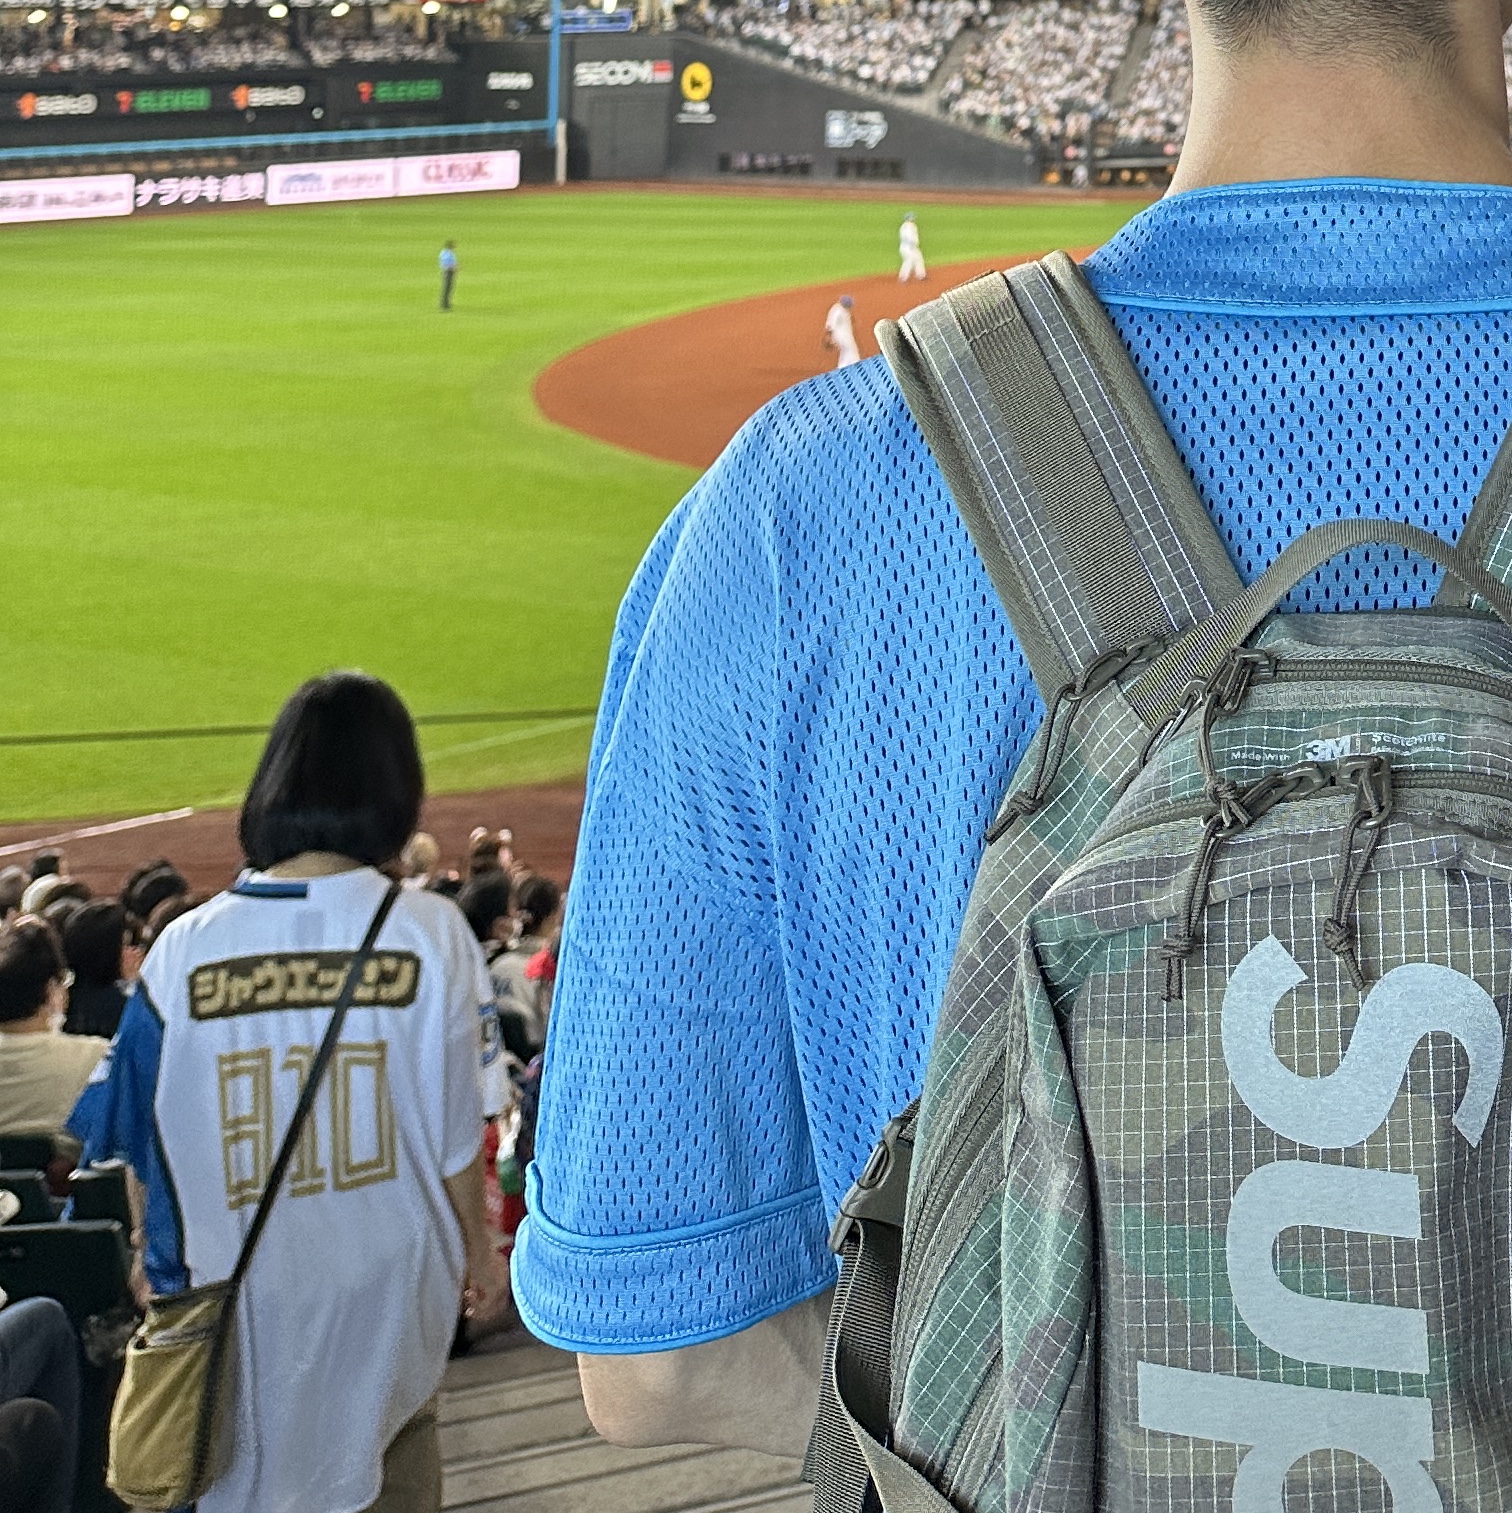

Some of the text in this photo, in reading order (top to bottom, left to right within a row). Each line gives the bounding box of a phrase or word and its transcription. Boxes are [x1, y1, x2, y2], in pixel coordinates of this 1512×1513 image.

[574, 59, 655, 87] SECOM
[1230, 736, 1351, 762] Made With 3M
[217, 1041, 398, 1210] 810
